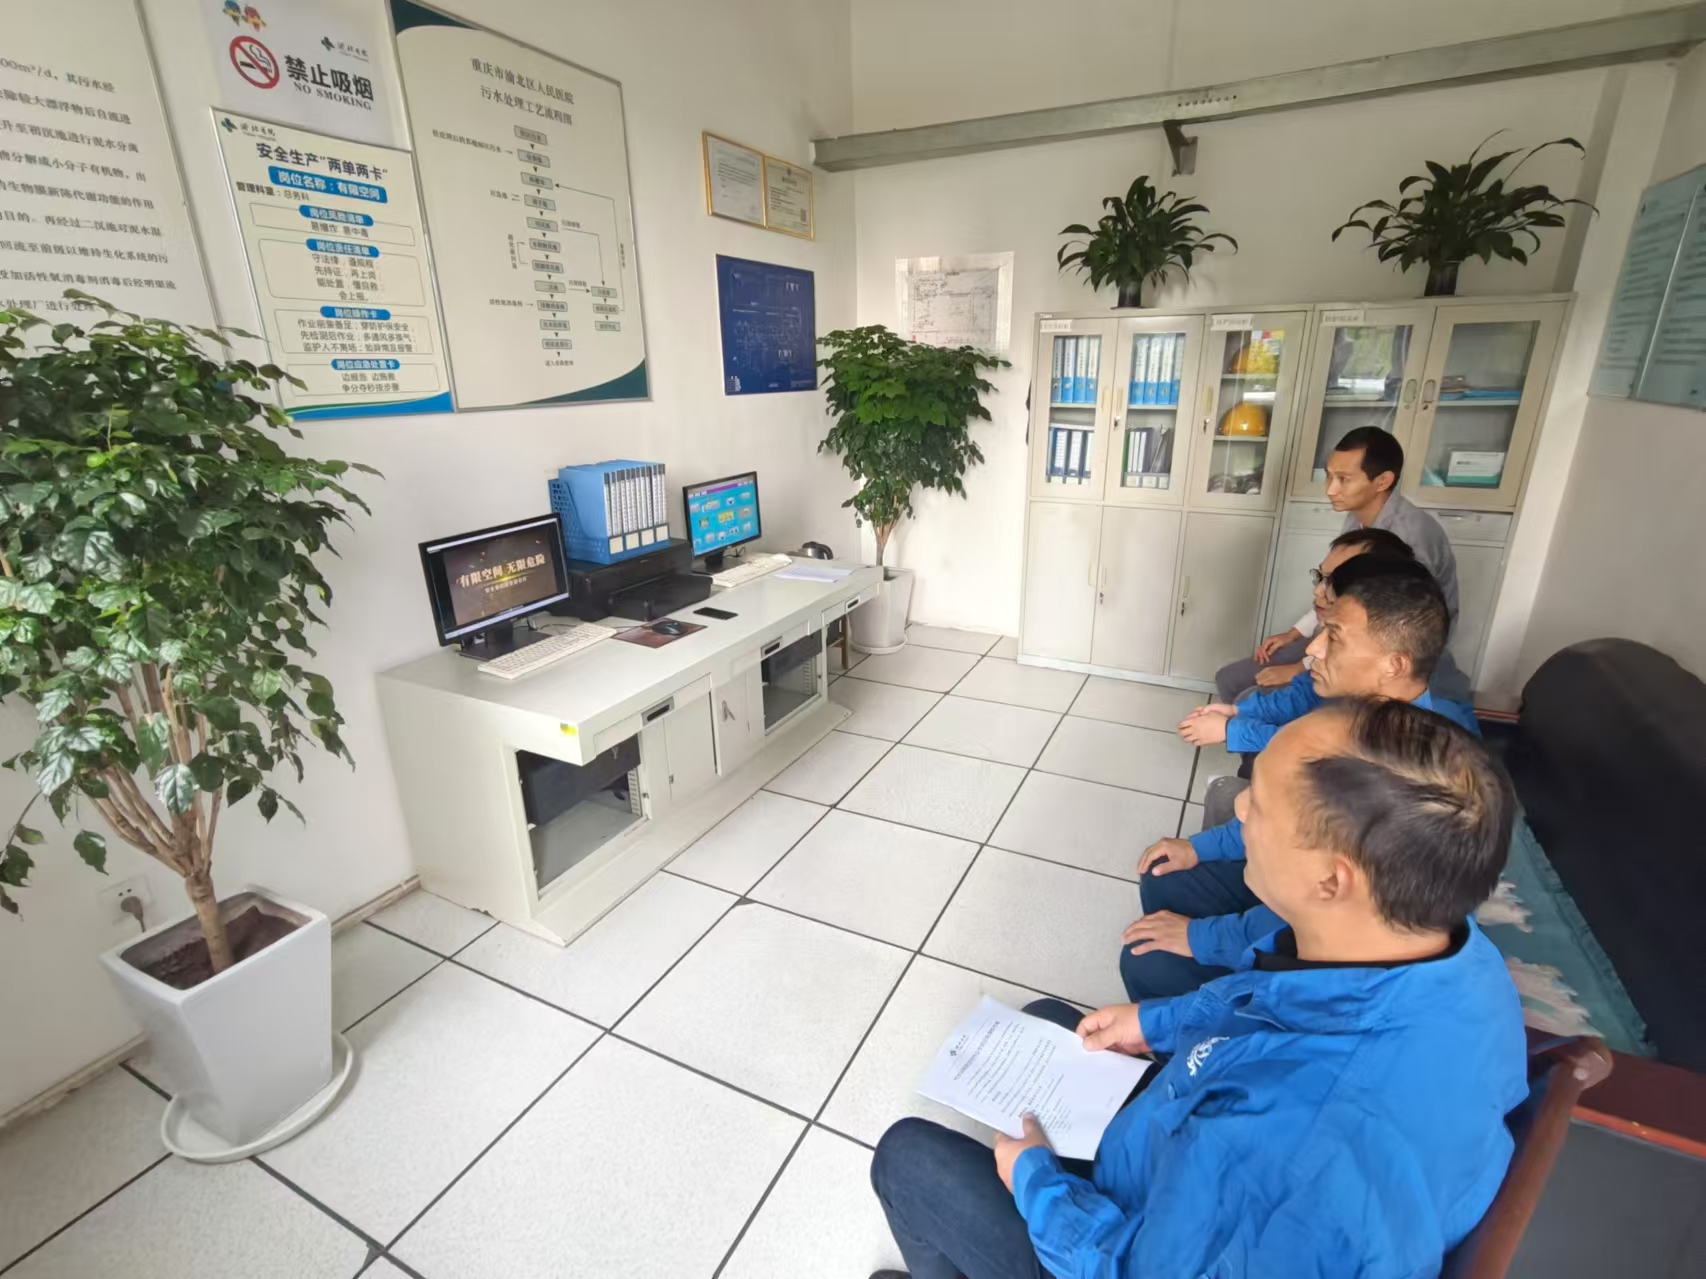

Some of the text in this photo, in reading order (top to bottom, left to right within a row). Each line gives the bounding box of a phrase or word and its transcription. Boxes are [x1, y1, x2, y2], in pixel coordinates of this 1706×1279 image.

[284, 54, 374, 101] 禁止吸烟
[470, 57, 574, 106] 重庆市渝北区人民医院
[293, 82, 372, 111] NO SMOKING
[480, 85, 573, 126] 污水处理工艺流程图
[0, 119, 139, 153] 升至初沉池进行泥水分离
[460, 567, 503, 587] 有限空间
